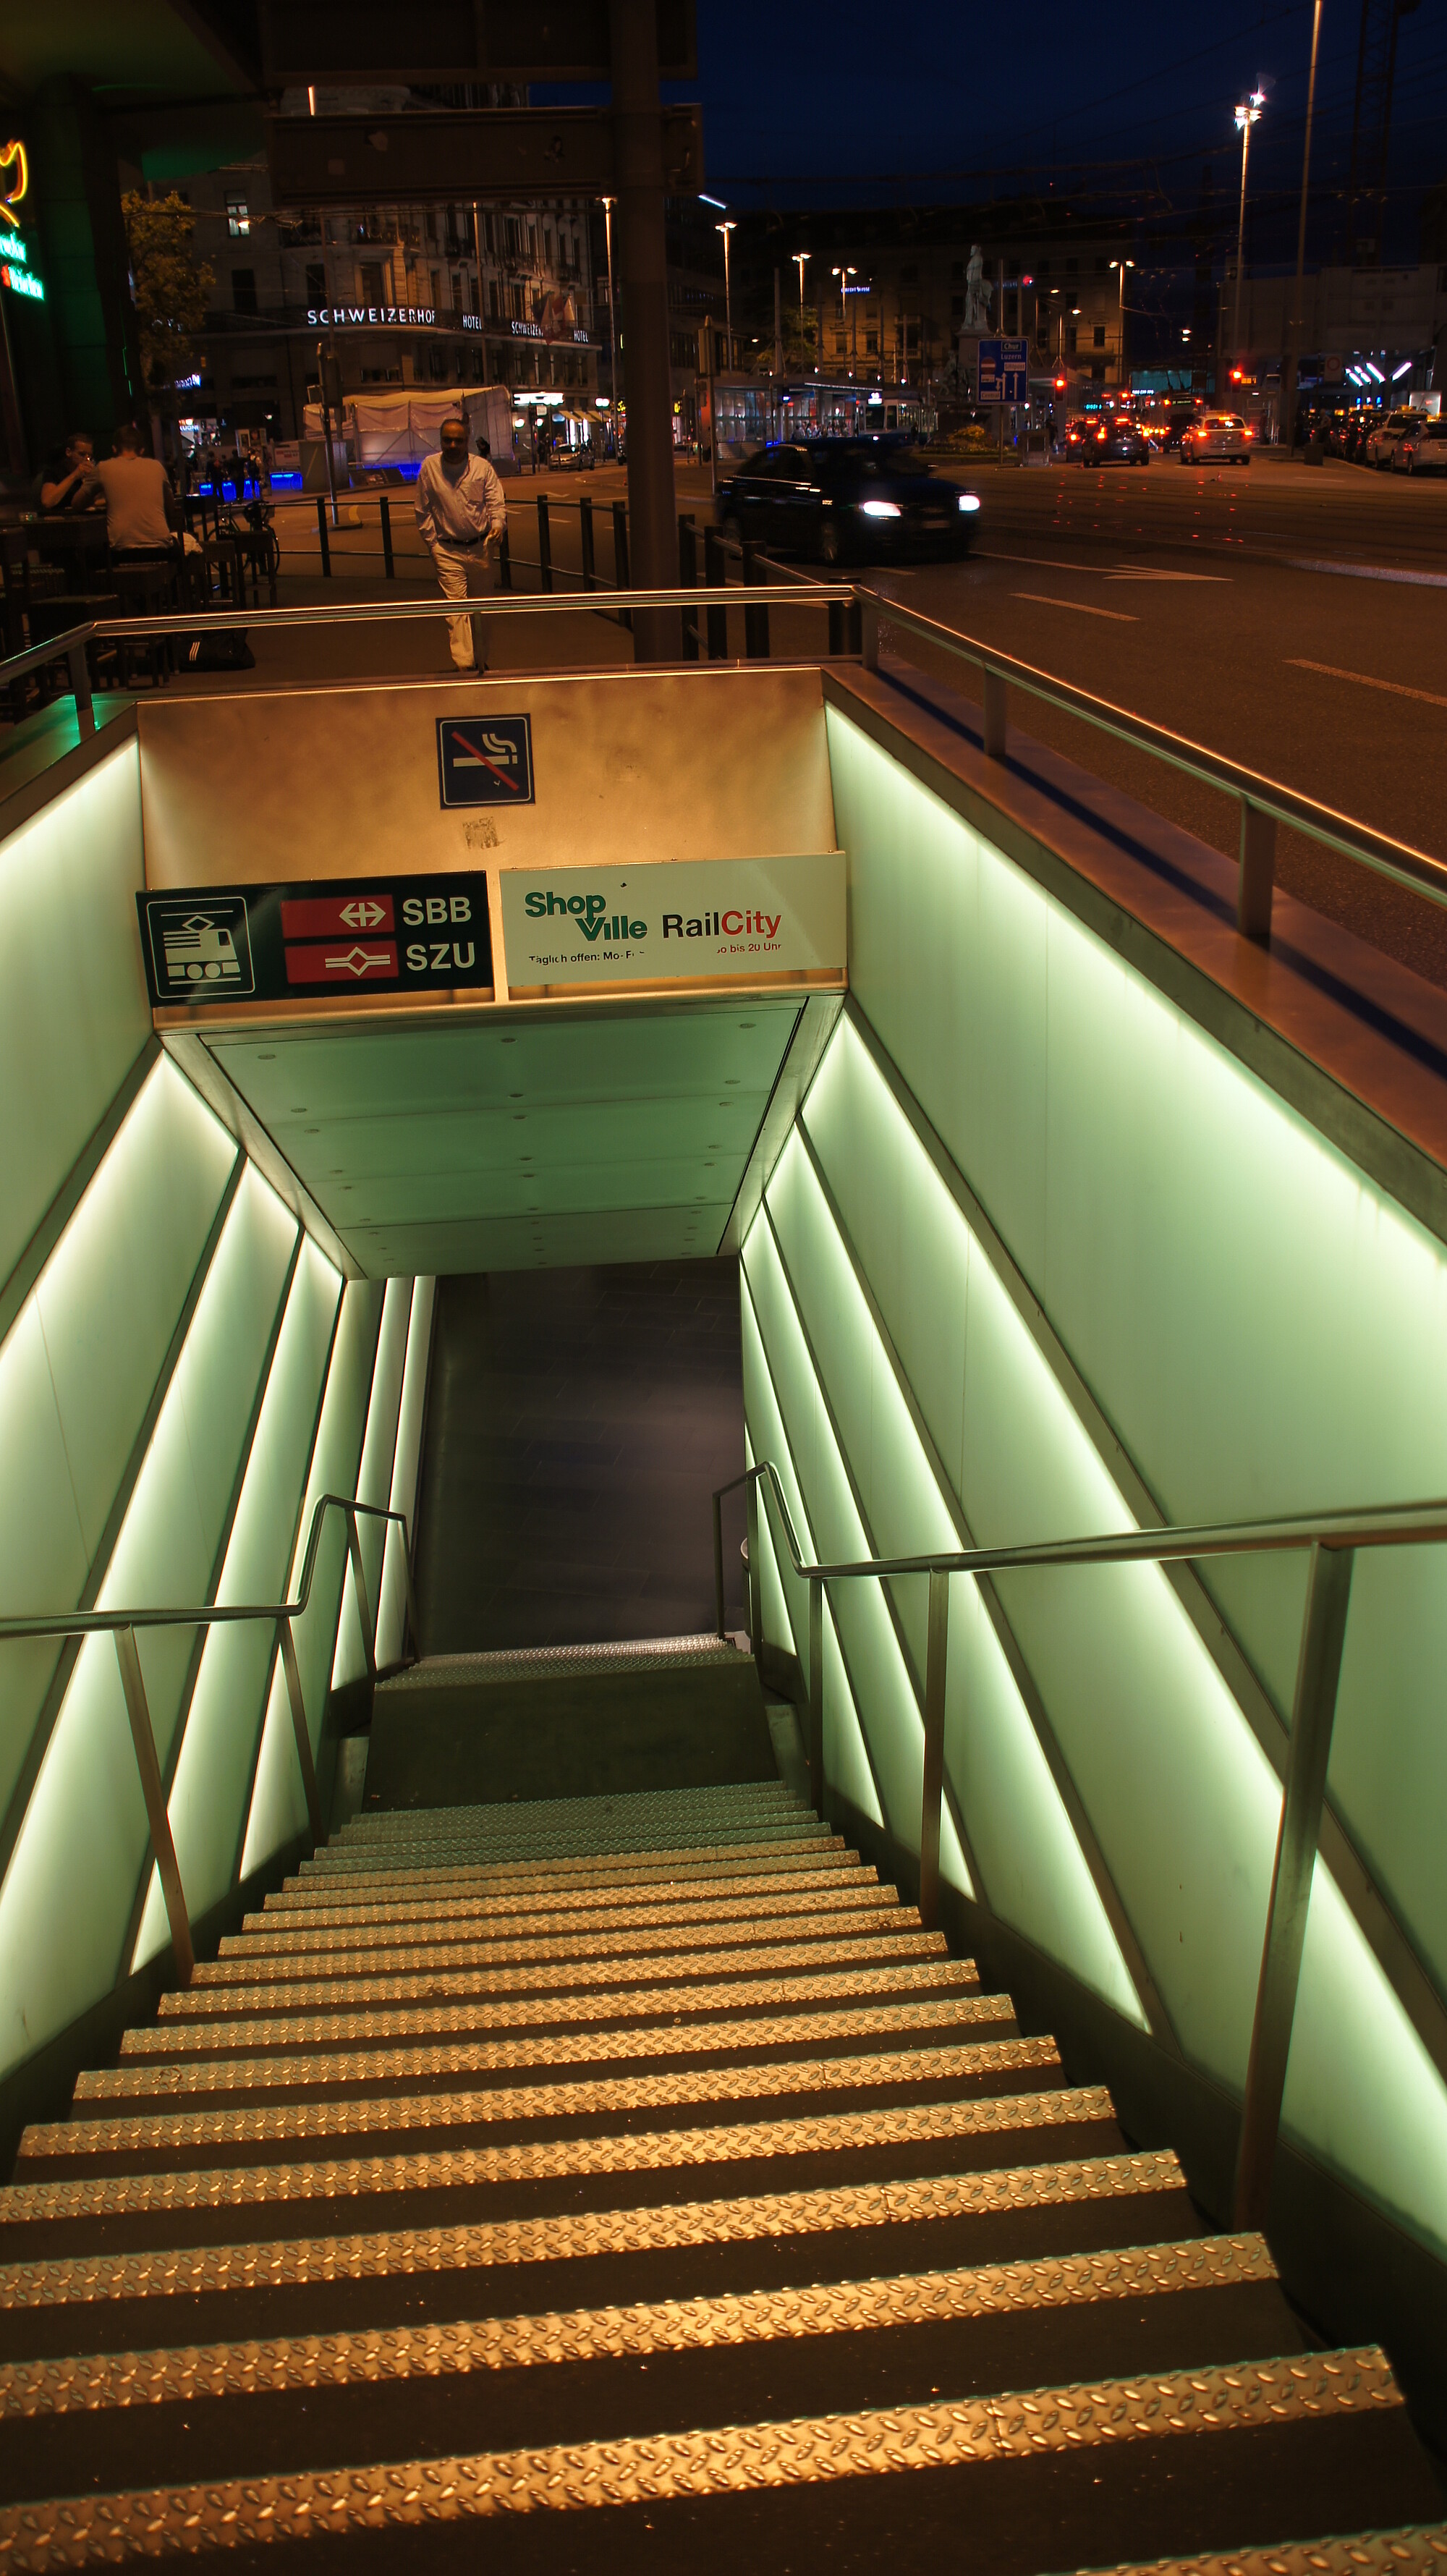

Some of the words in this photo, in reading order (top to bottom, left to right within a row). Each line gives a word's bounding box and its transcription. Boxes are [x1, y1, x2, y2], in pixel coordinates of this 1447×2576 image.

[307, 308, 436, 324] SCHWEIZERHOF
[462, 314, 483, 330] HOTEL
[574, 329, 589, 343] HOTEL
[402, 897, 472, 926] SBB
[525, 891, 606, 919] Shop
[574, 915, 648, 941] Ville
[662, 910, 782, 940] RailCity
[406, 942, 475, 971] SZU
[570, 953, 600, 963] offen:
[730, 944, 745, 953] bis
